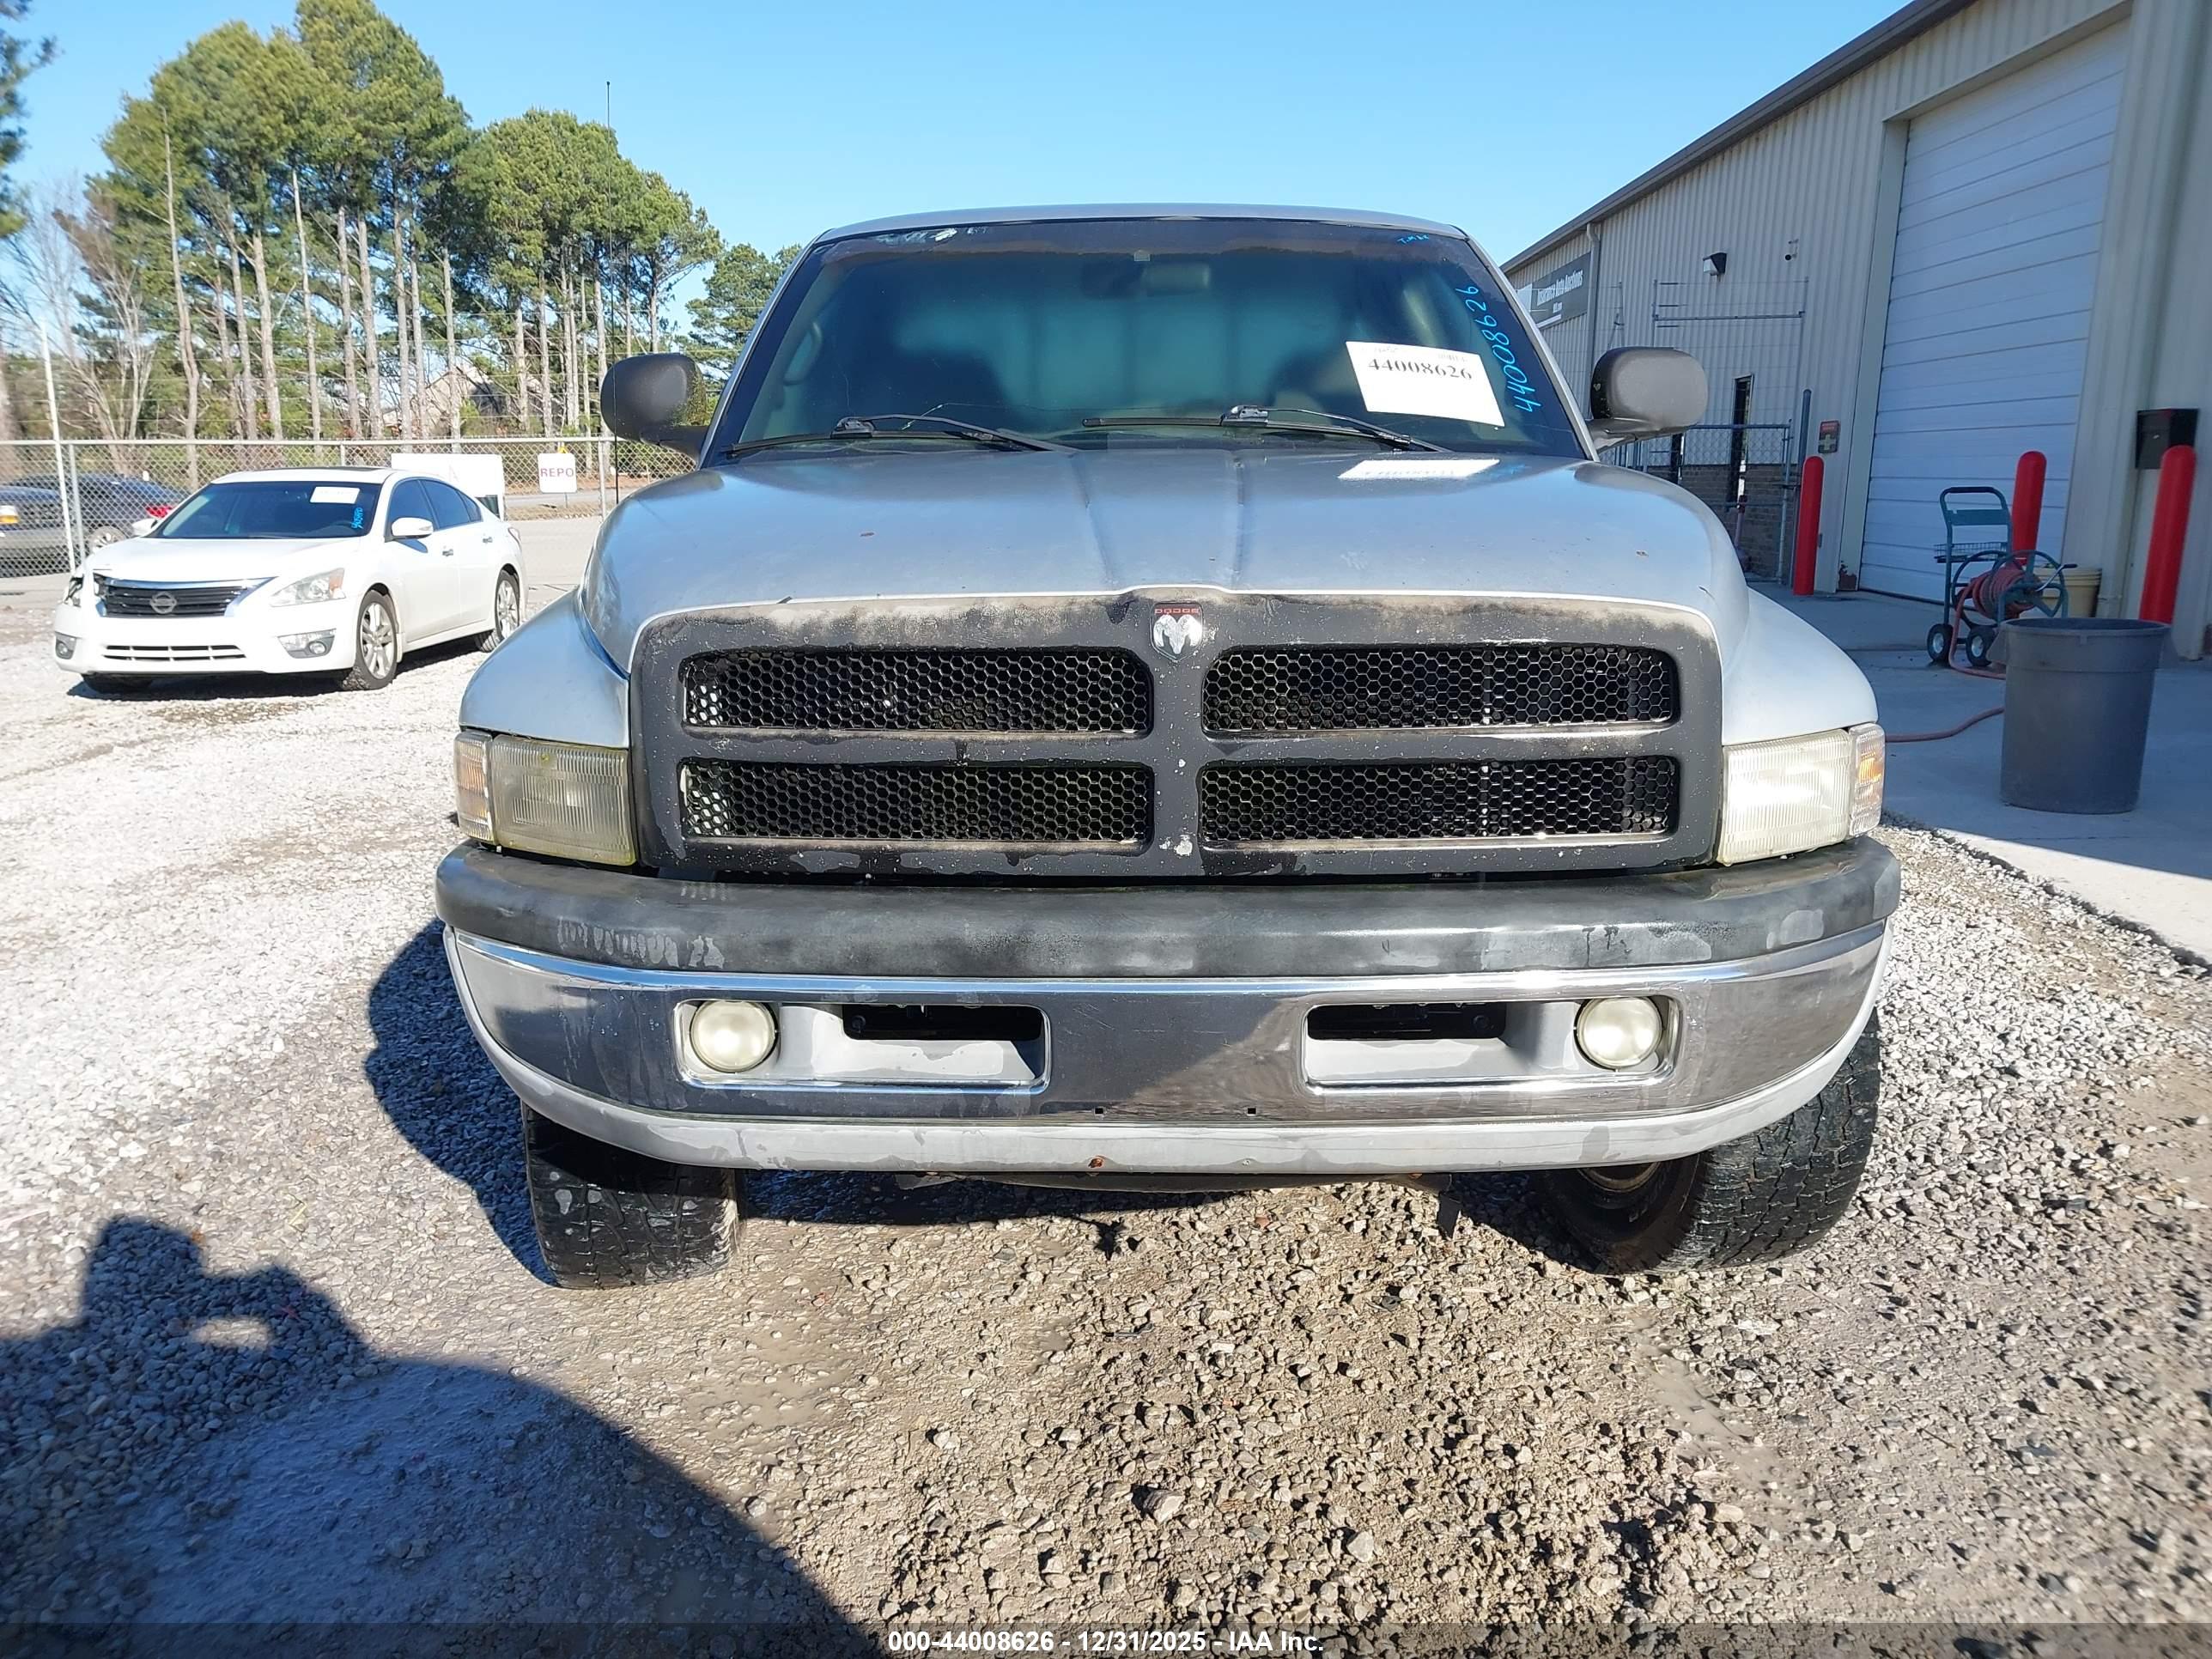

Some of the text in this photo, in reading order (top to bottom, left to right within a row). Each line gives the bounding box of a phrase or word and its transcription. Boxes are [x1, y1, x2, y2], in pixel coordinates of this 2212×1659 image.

[1455, 285, 1542, 413] 44008626
[1368, 358, 1473, 380] 44008626
[540, 468, 574, 477] REPO
